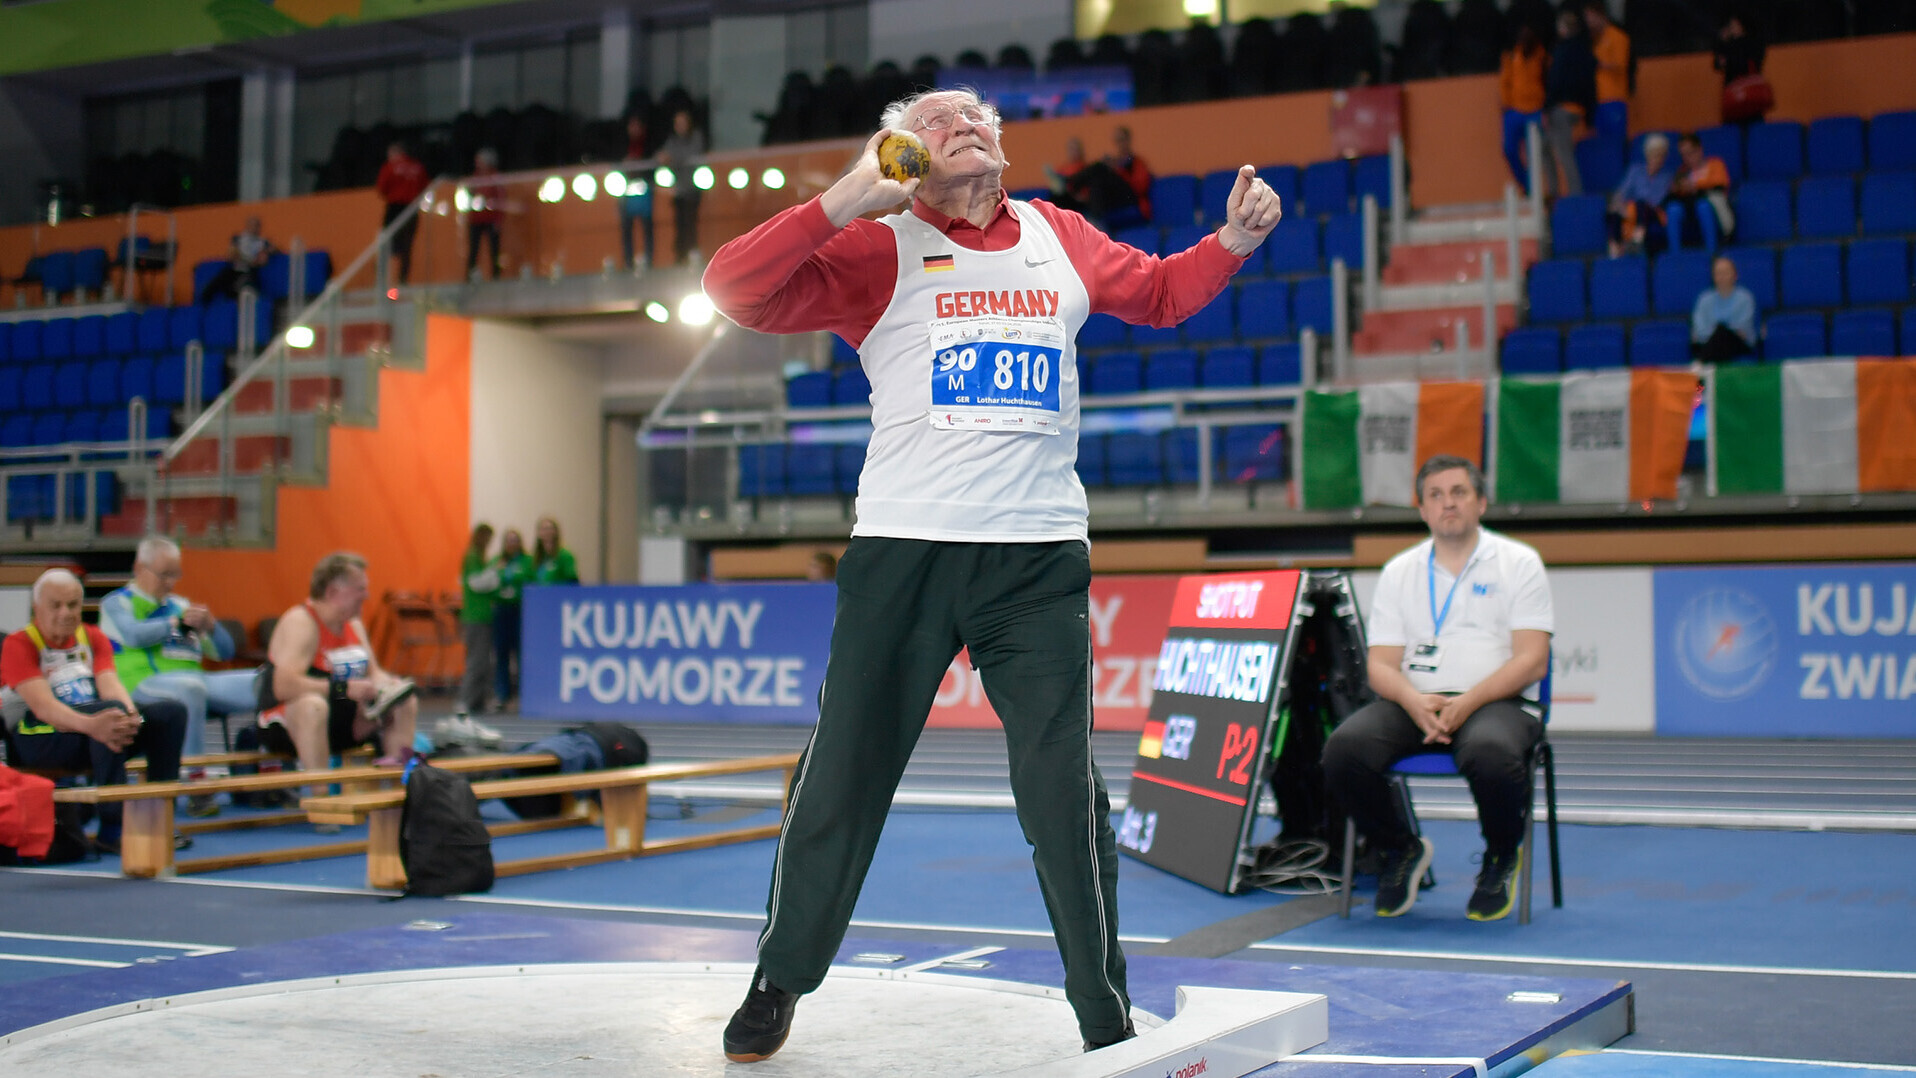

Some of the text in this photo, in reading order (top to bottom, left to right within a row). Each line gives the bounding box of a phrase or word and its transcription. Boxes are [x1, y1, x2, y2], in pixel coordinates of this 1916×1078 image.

[935, 289, 1059, 319] GERMANY
[939, 348, 1050, 393] 90 810
[948, 374, 965, 391] M
[955, 395, 1042, 407] GER Lothar Huchthausen
[1196, 581, 1264, 619] SHOT PUT
[1798, 583, 1916, 636] KUJ
[560, 602, 763, 649] KUJAWY
[560, 656, 803, 706] POMORZE
[1153, 637, 1279, 703] HUCHTHAUSEN
[1163, 714, 1196, 760] GER
